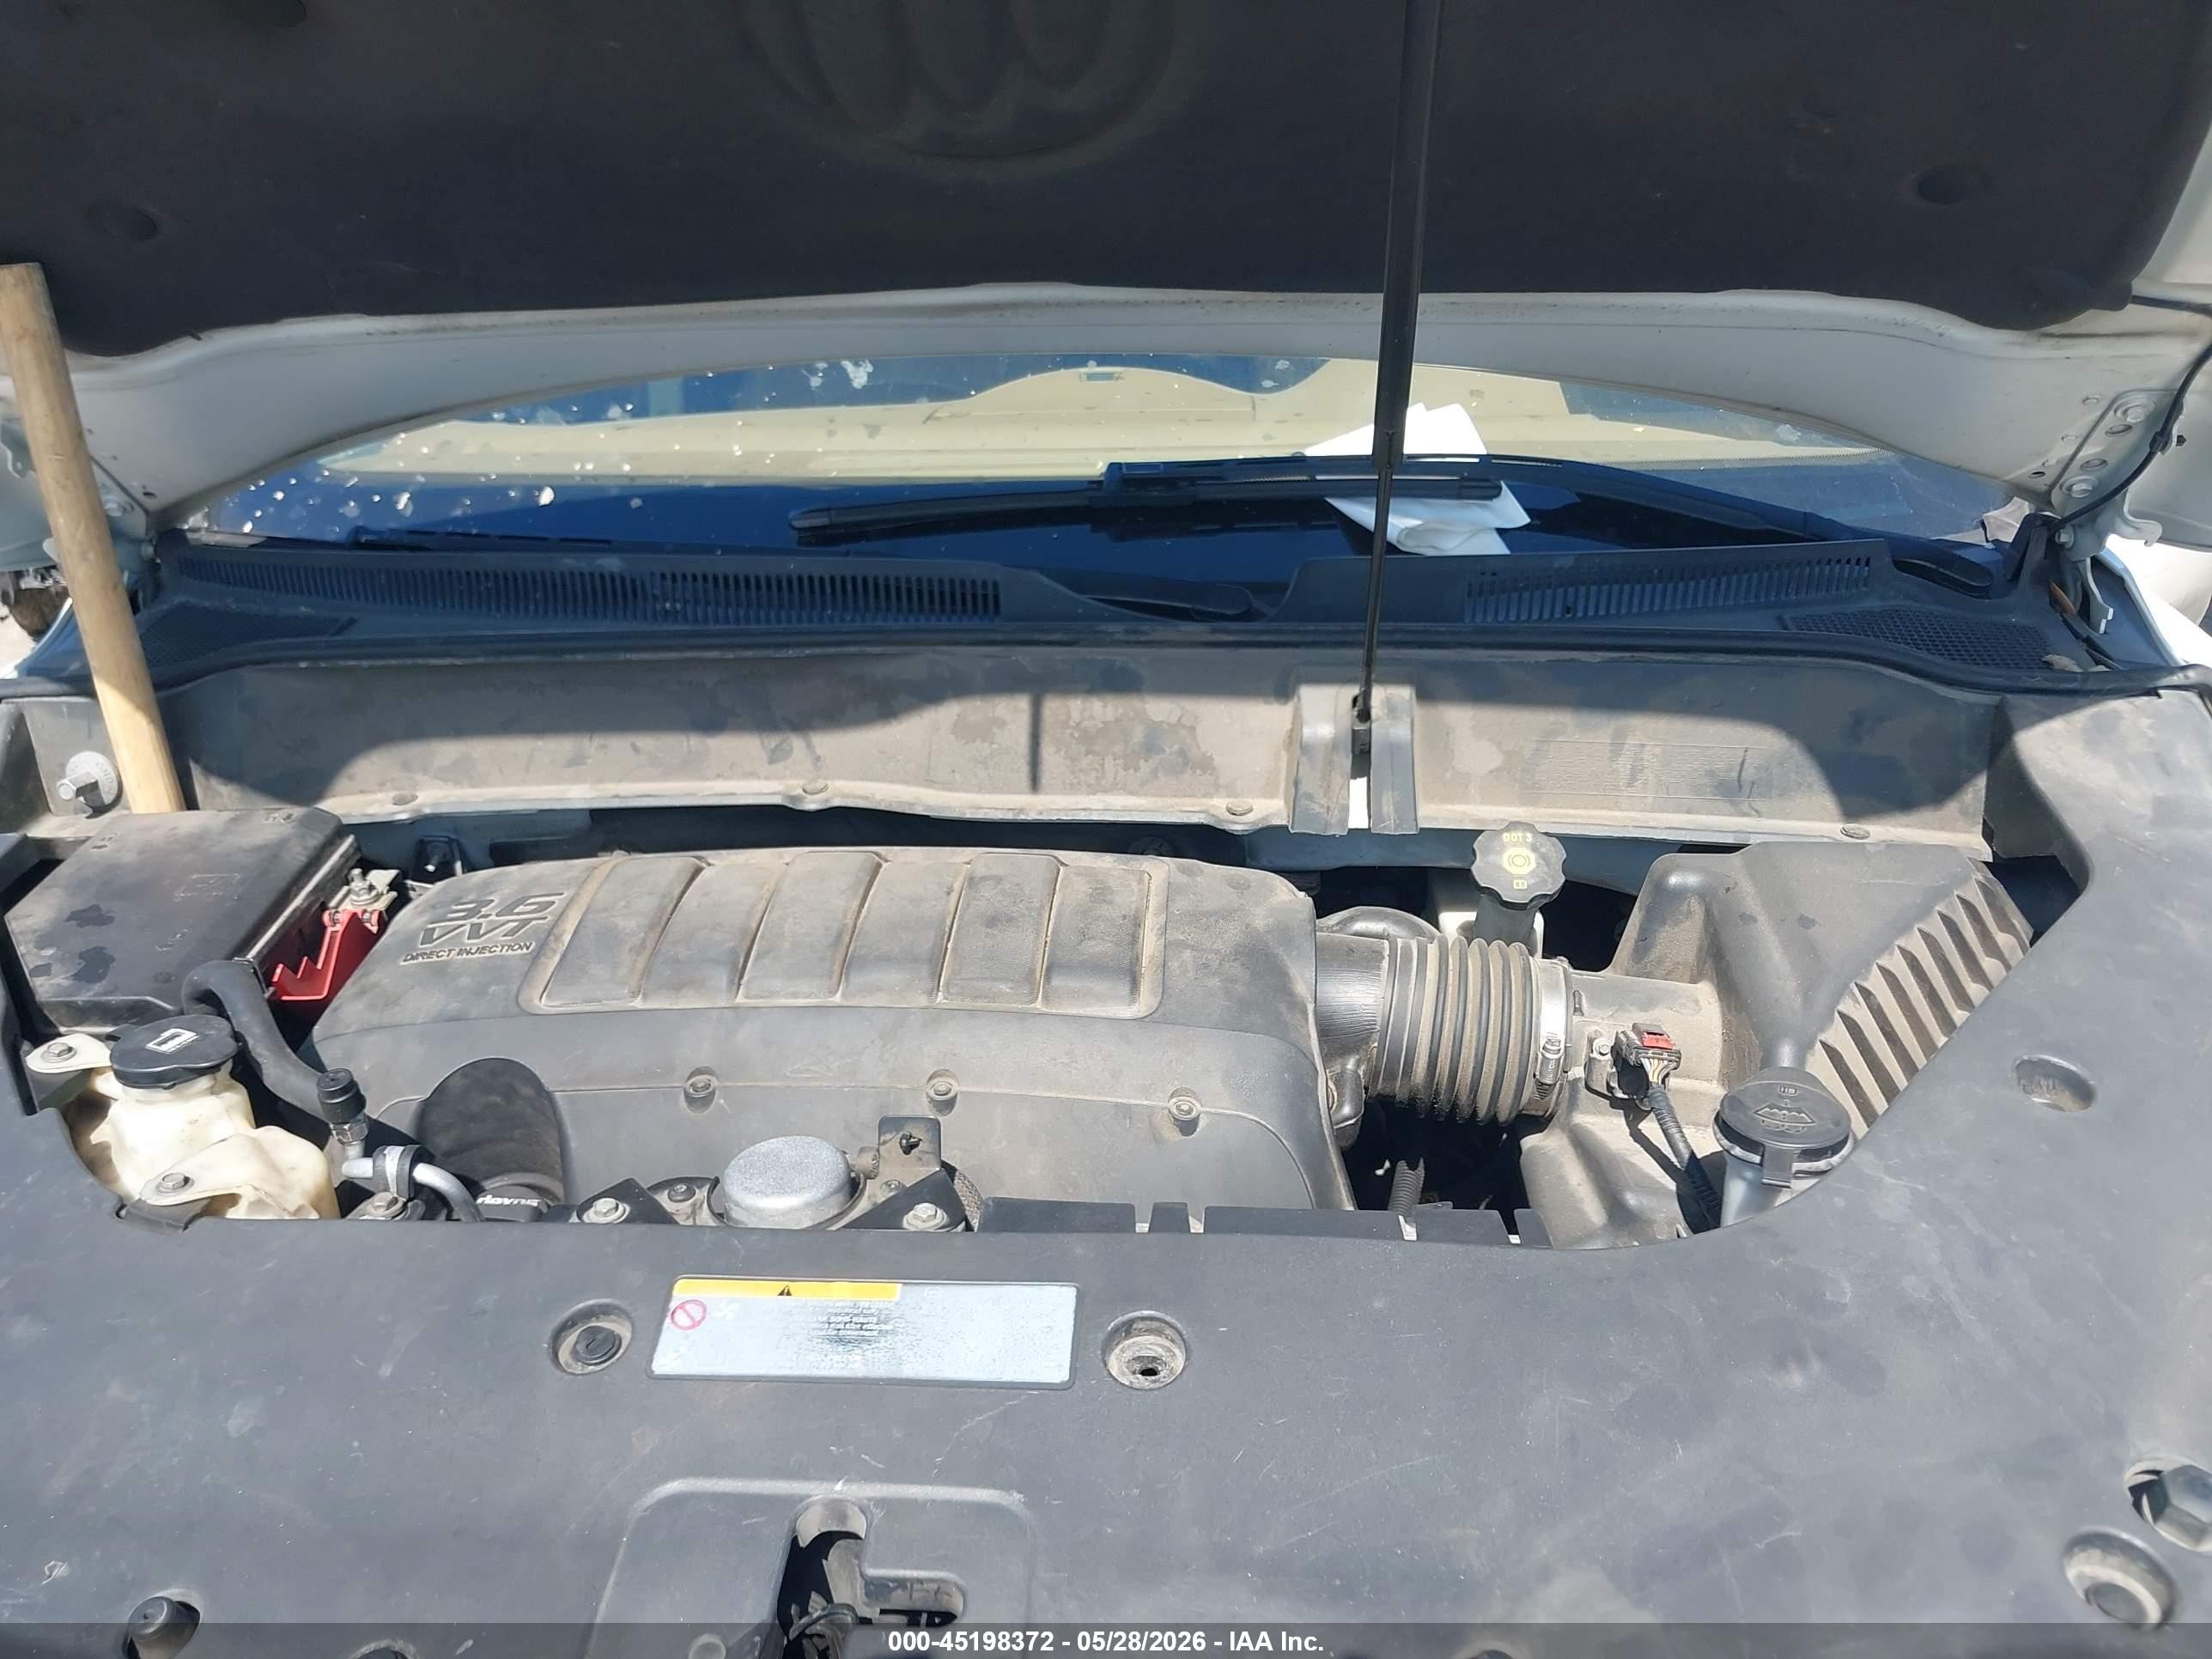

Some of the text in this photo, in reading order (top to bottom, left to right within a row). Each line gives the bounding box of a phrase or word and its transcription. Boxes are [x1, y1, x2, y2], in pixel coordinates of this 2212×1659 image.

[1503, 832, 1523, 843] DOT
[442, 892, 565, 920] 3.6
[419, 916, 549, 947] VVT
[401, 942, 534, 963] DIRECT INJECTION
